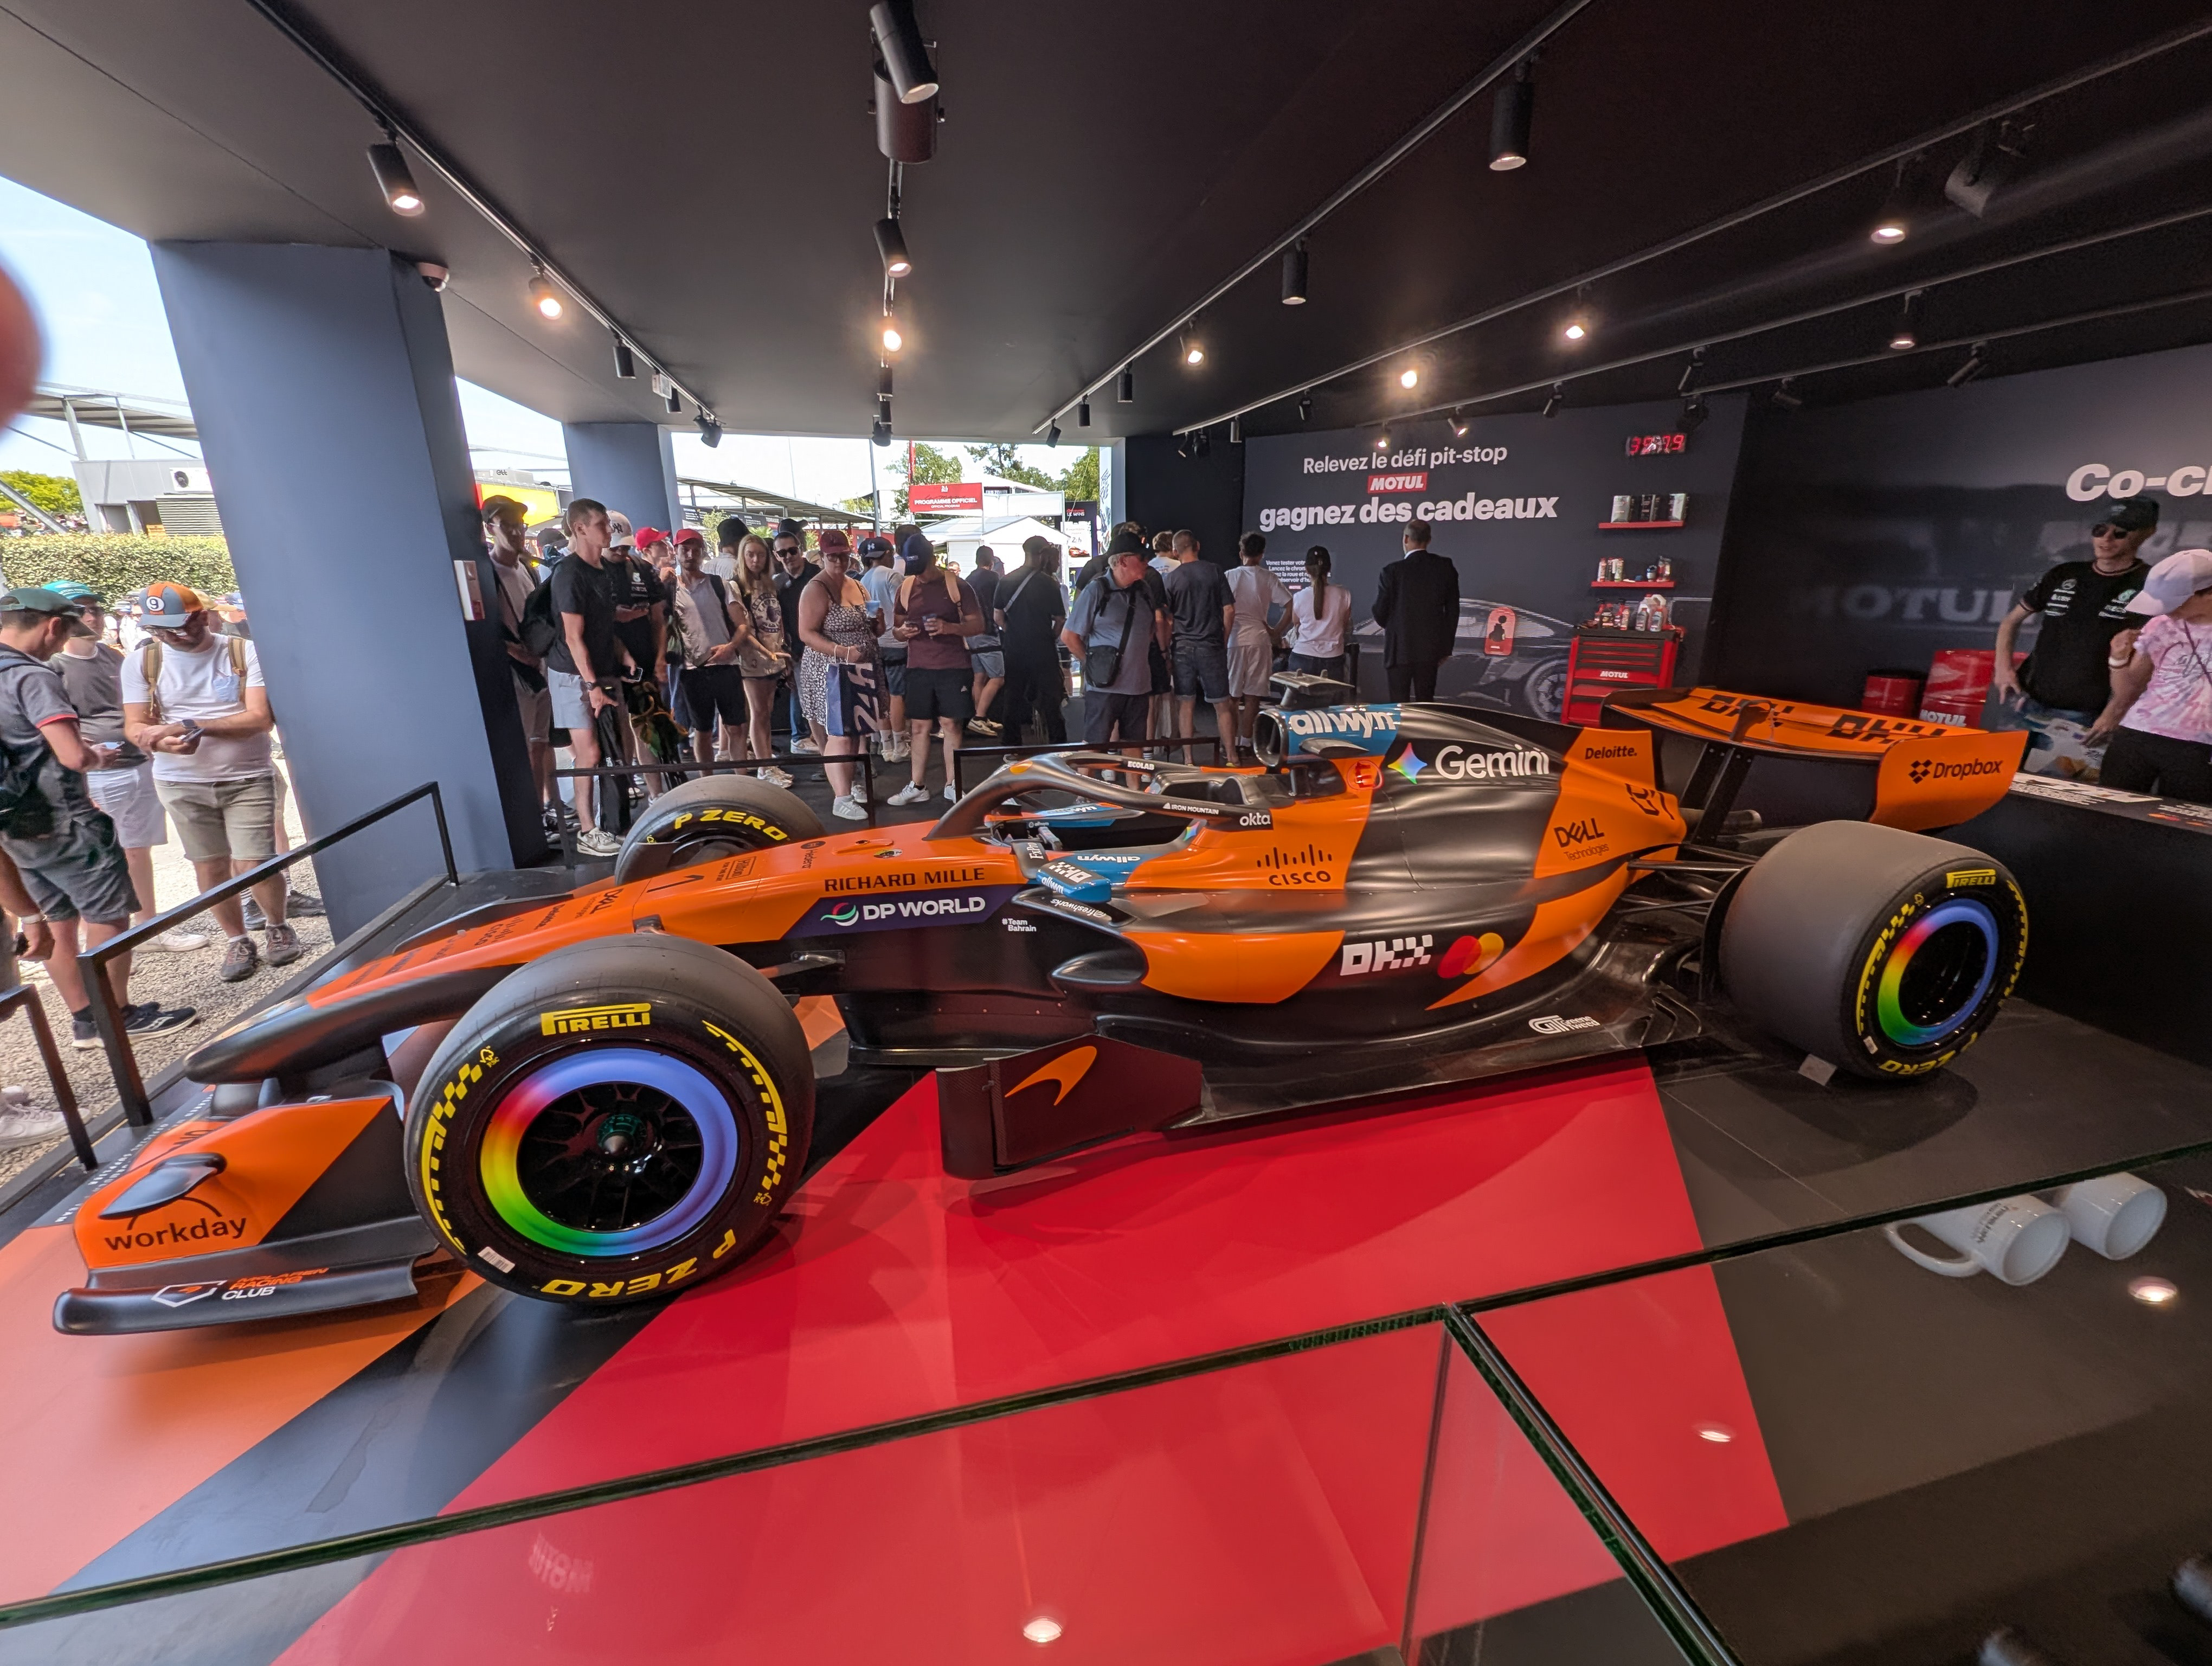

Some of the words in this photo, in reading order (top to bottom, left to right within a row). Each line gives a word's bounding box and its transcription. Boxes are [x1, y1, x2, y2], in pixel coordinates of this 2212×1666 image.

[1303, 456, 1368, 474] Relevez
[1372, 452, 1387, 470] le
[1391, 447, 1426, 467] défi
[1430, 447, 1507, 469] pit-stop
[1370, 476, 1424, 491] MOTUL
[2066, 463, 2212, 502] Co-c
[1259, 503, 1356, 532] gagnez
[1359, 497, 1412, 523] des
[1416, 492, 1560, 522] cadeaux
[149, 598, 159, 610] 9
[1288, 709, 1397, 738] allwyn
[1920, 709, 1966, 727] MOTUL
[1435, 744, 1549, 780] Gemini
[1585, 746, 1637, 760] Deloitte.
[1127, 761, 1154, 770] ECOLAB
[1933, 758, 2003, 780] Dropbox
[1187, 805, 1219, 815] MOUNTAIN
[1239, 812, 1271, 826] okta
[674, 812, 693, 830] P
[699, 809, 788, 842] ZERO
[1554, 818, 1605, 848] DELL
[1027, 842, 1044, 860] FxPro
[1077, 854, 1141, 863] allwyn
[1564, 843, 1609, 861] Technologies
[824, 873, 916, 893] RICHARD
[923, 867, 986, 886] MILLE
[1269, 870, 1332, 887] CISCO
[1946, 869, 1996, 889] PIRELLI
[863, 901, 896, 921] DP
[898, 896, 986, 918] WORLD
[1051, 898, 1095, 917] freshworks
[1340, 934, 1433, 976] OKX
[541, 1003, 652, 1036] PIRELLI
[1560, 1016, 1592, 1026] Greene
[104, 1216, 248, 1252] workday
[712, 1228, 737, 1259] P
[229, 1276, 303, 1290] RACING
[237, 1267, 330, 1283] MCLAREN
[540, 1257, 698, 1298] ZERO
[221, 1286, 276, 1300] CLUB
